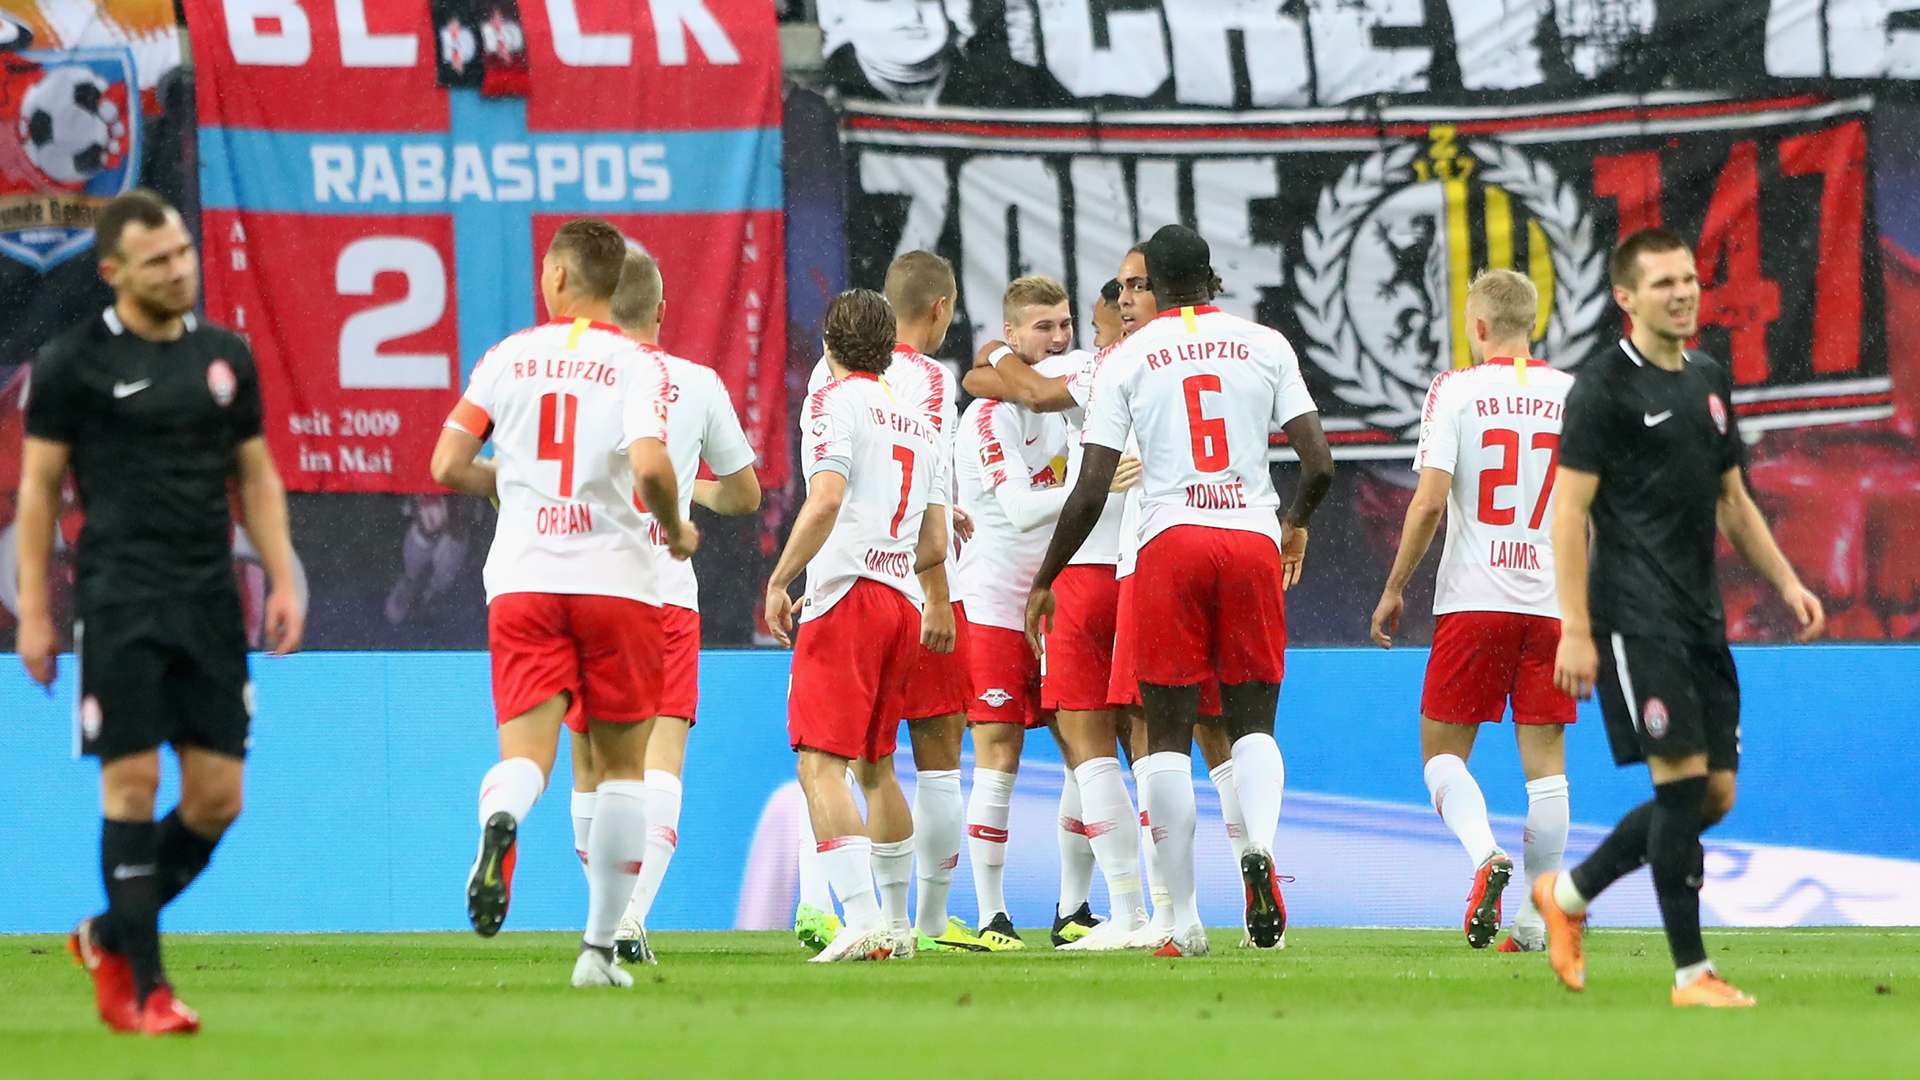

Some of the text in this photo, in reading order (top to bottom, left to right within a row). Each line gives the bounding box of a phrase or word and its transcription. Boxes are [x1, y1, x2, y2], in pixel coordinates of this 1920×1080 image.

[223, 0, 741, 67] BLCK
[309, 144, 672, 202] RABASPOS
[514, 359, 617, 387] RB LEIPZIG
[1146, 341, 1250, 371] RB LEIPZIG
[288, 408, 400, 437] seit 2009
[1183, 374, 1230, 474] 6
[1476, 397, 1500, 417] RB
[300, 442, 393, 474] im Mai
[536, 392, 578, 498] 4
[889, 444, 915, 539] 7
[1477, 428, 1562, 530] 27
[1490, 540, 1541, 570] LAIMR
